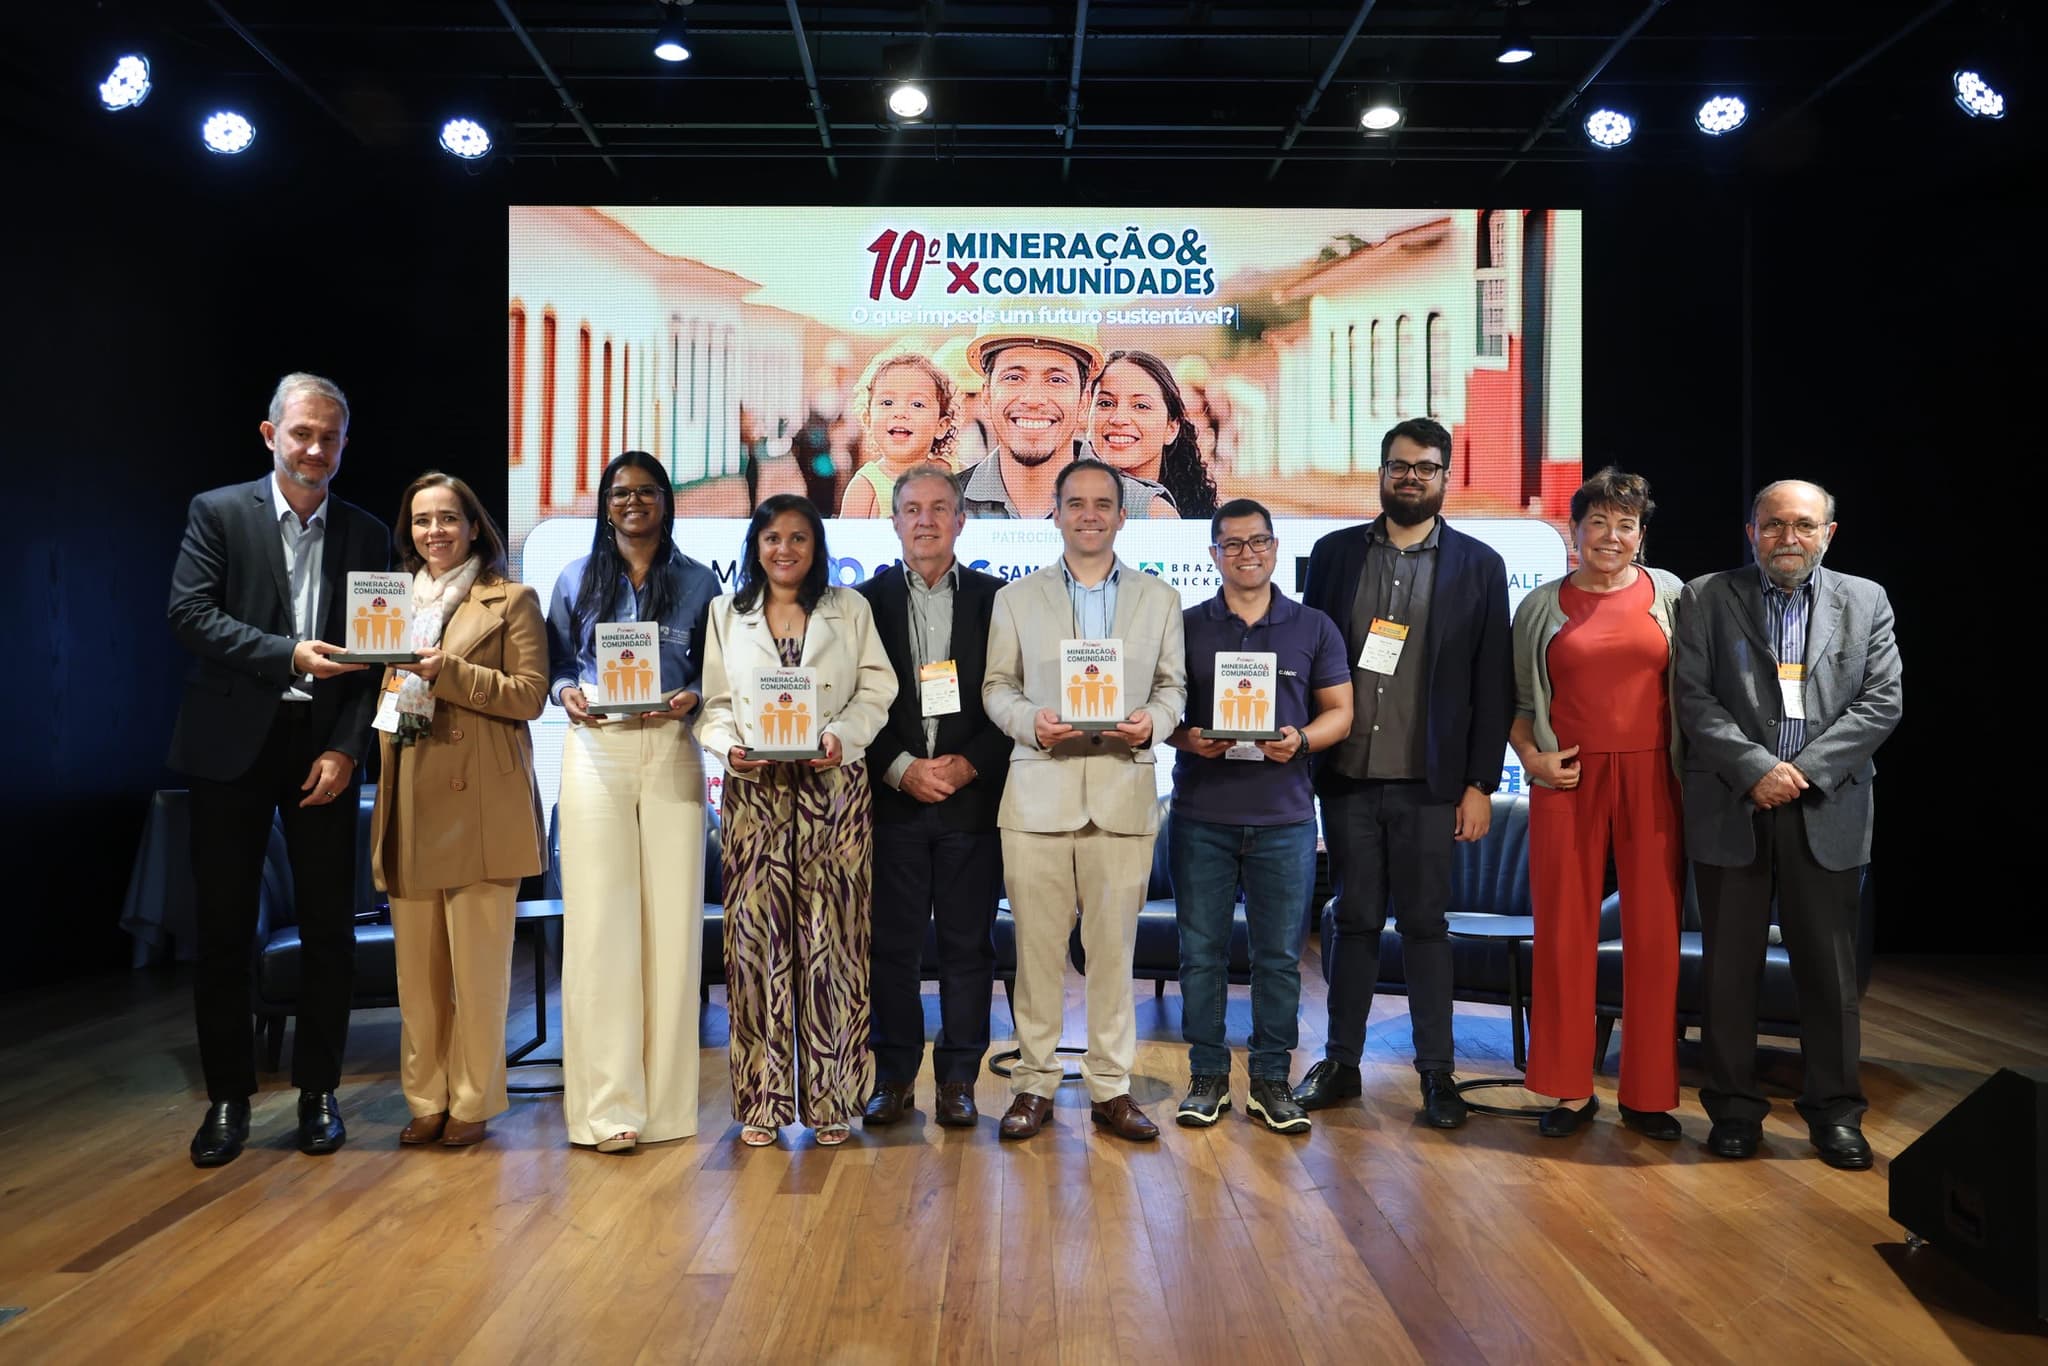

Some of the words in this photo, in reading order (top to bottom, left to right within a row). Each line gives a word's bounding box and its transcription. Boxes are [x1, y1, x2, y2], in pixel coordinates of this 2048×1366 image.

[946, 226, 1207, 266] MINERAÇÃO&
[982, 266, 1215, 295] COMUNIDADES
[852, 306, 869, 325] O
[876, 309, 913, 328] que
[917, 305, 996, 328] impede
[999, 309, 1036, 325] um
[1037, 306, 1103, 325] futuro
[1105, 304, 1234, 325] sustentável?
[1171, 563, 1213, 573] BRAZ
[1171, 576, 1221, 586] NICKE
[353, 587, 406, 595] COMUNIDADES
[601, 640, 652, 648] COMUNIDADES
[1066, 655, 1117, 663] COMUNIDADES
